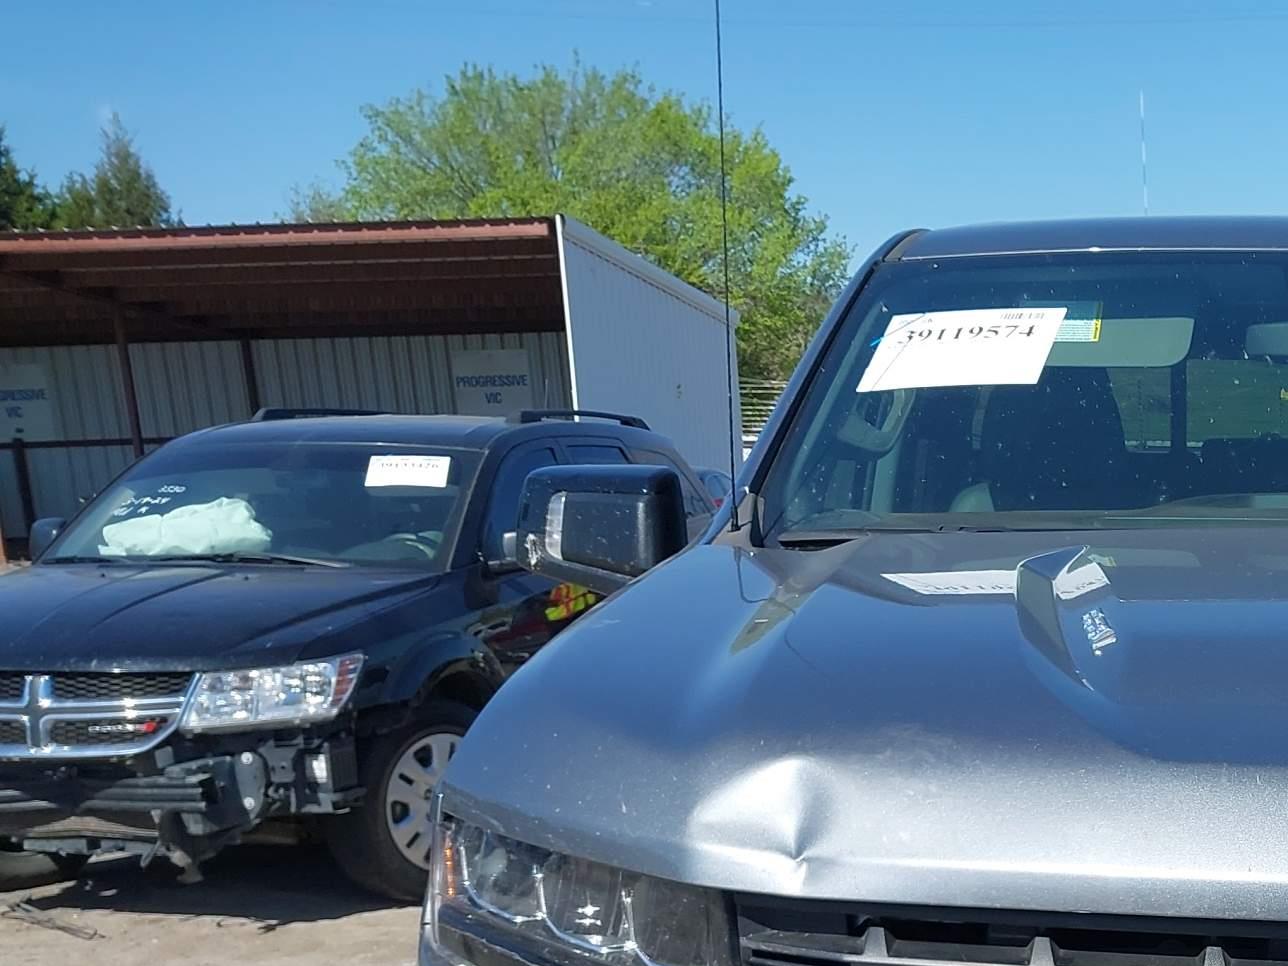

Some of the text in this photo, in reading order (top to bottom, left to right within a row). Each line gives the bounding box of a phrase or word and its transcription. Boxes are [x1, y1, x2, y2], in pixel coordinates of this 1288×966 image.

[897, 324, 1036, 346] 39119574
[456, 374, 528, 388] PROGRESSIVE
[485, 392, 502, 404] VIC
